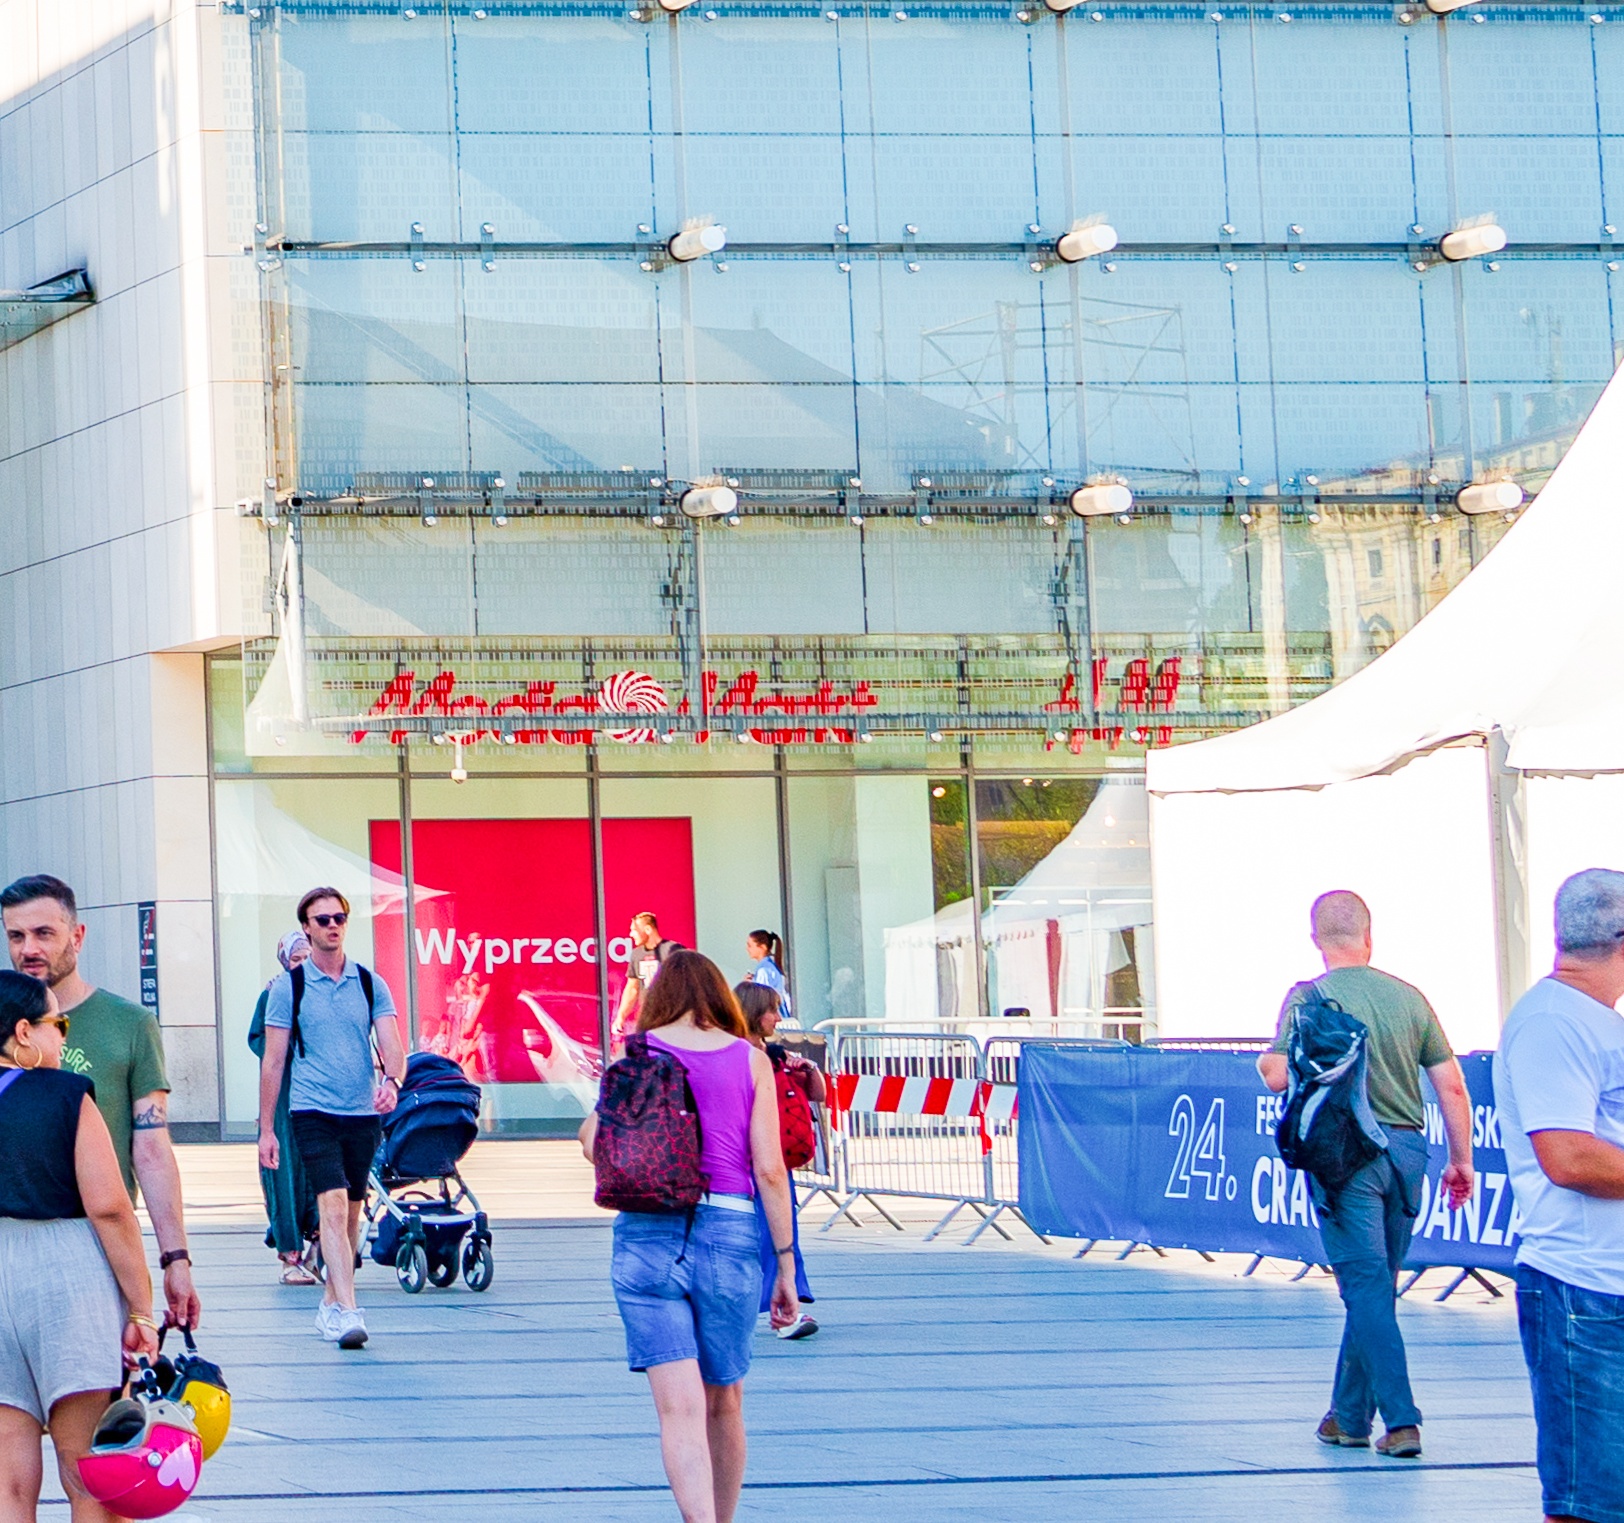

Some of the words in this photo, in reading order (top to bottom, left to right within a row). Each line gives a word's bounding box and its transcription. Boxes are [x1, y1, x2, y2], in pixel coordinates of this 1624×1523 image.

[348, 670, 597, 746] Media
[674, 669, 879, 746] Markt
[1165, 1093, 1238, 1201] 24.
[1251, 1155, 1320, 1230] CRA
